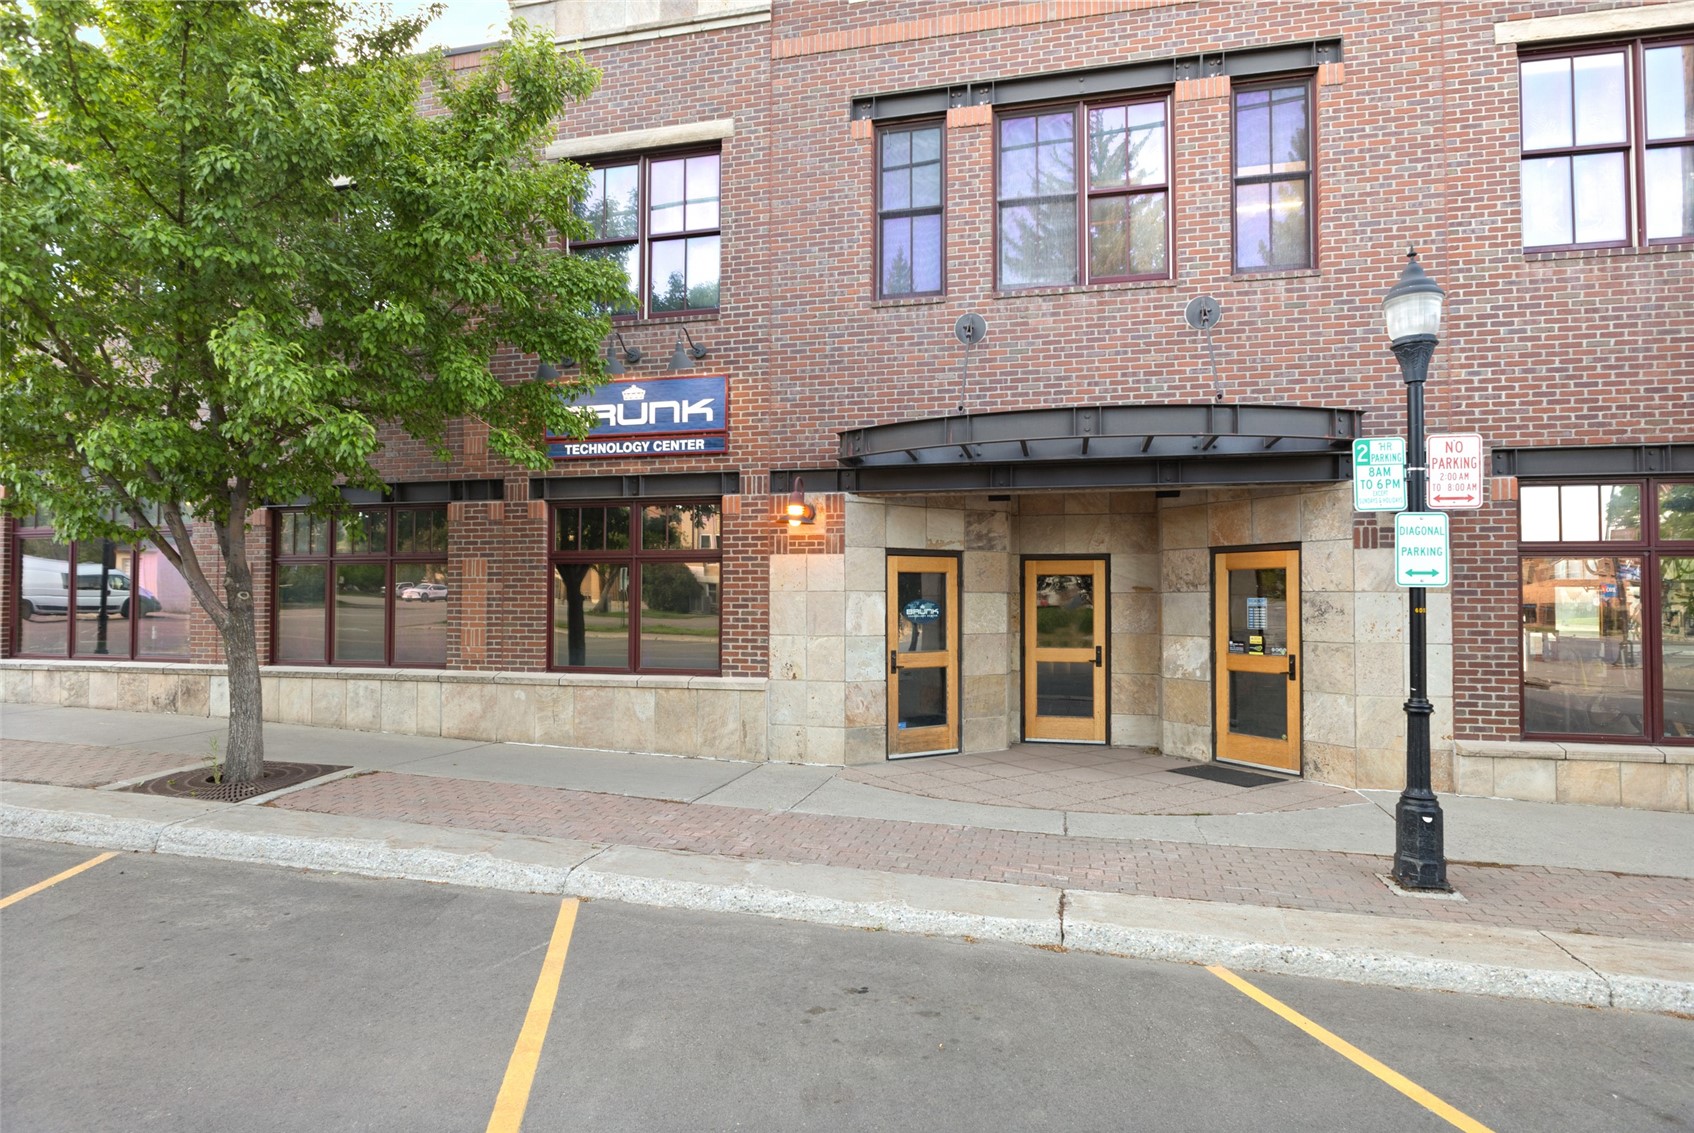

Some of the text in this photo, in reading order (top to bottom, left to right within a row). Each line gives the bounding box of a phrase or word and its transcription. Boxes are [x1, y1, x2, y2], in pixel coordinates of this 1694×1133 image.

[564, 439, 705, 455] TECHNOLOGY CENTER
[1379, 442, 1392, 451] HR
[1445, 440, 1463, 453] NO
[1356, 444, 1368, 462] 2
[1371, 453, 1402, 462] PARKING
[1431, 456, 1477, 469] PARKING
[1361, 479, 1373, 489] TO
[1432, 483, 1441, 491] TO
[1400, 526, 1444, 536] DIAGONAL
[1401, 546, 1443, 556] PARKING
